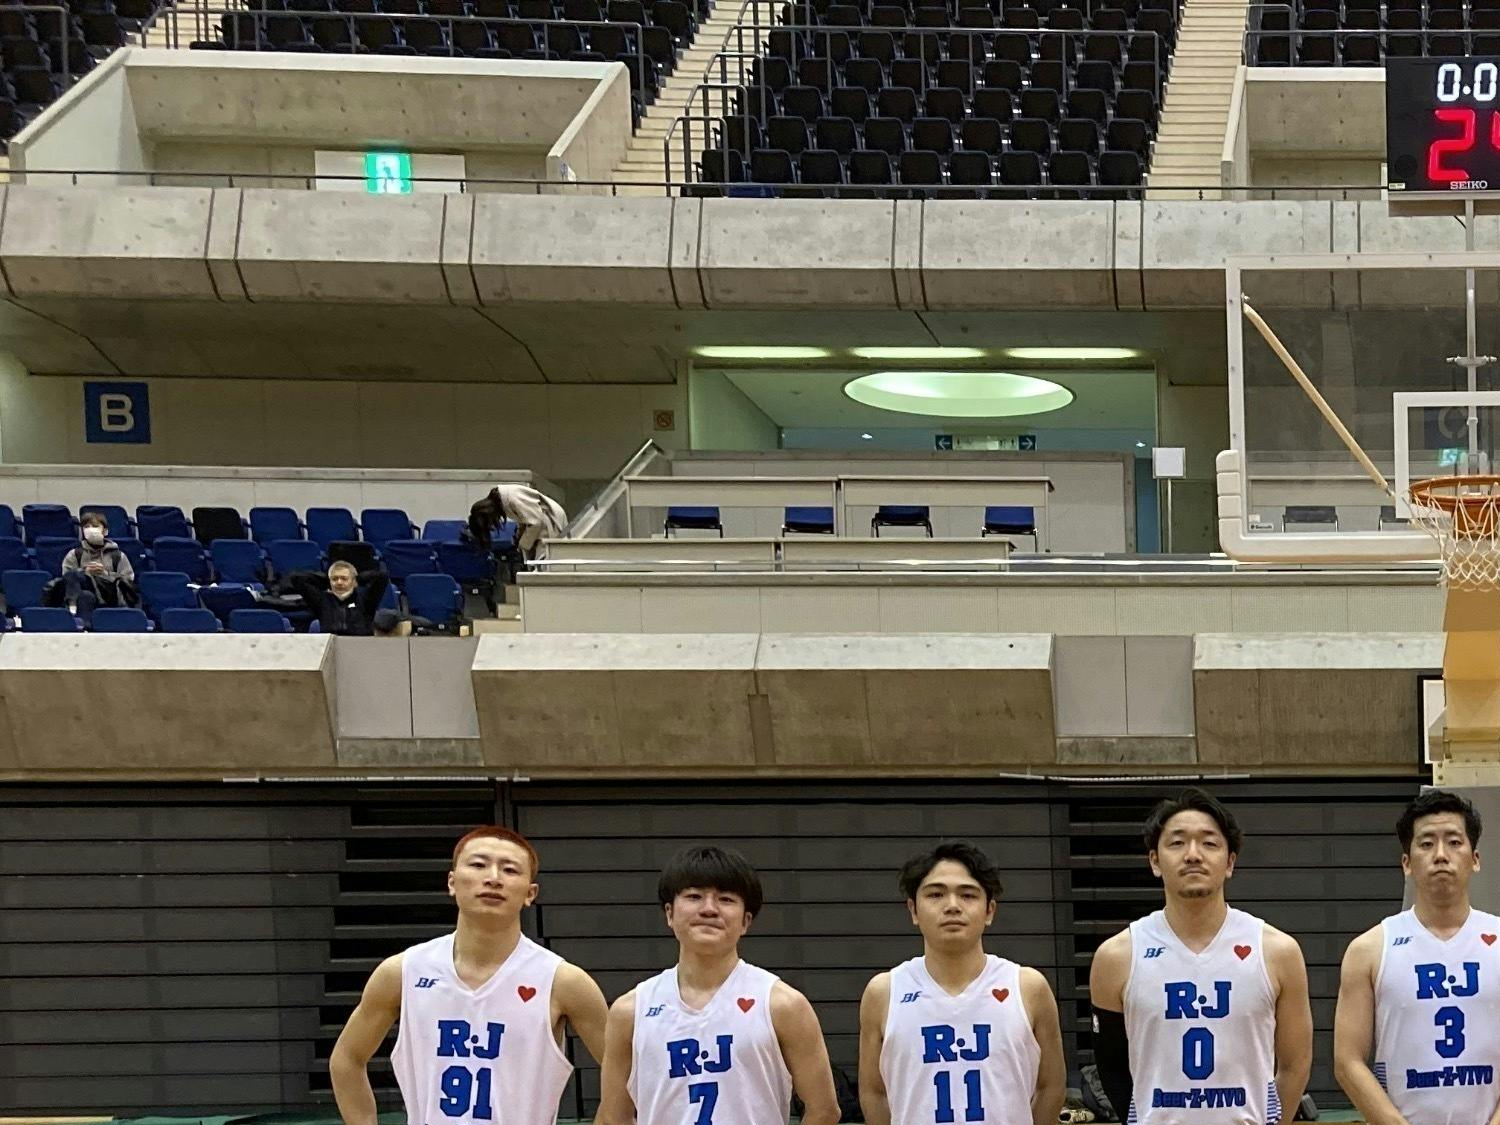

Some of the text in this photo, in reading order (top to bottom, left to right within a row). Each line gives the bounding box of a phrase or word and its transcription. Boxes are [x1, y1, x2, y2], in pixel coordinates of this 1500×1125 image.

[1437, 63, 1498, 102] 0.0
[1450, 181, 1488, 190] SEIKO
[100, 393, 135, 432] B
[1182, 1027, 1214, 1080] 0
[1435, 1006, 1465, 1058] 3
[440, 1066, 492, 1120] 91
[934, 1070, 984, 1123] 11
